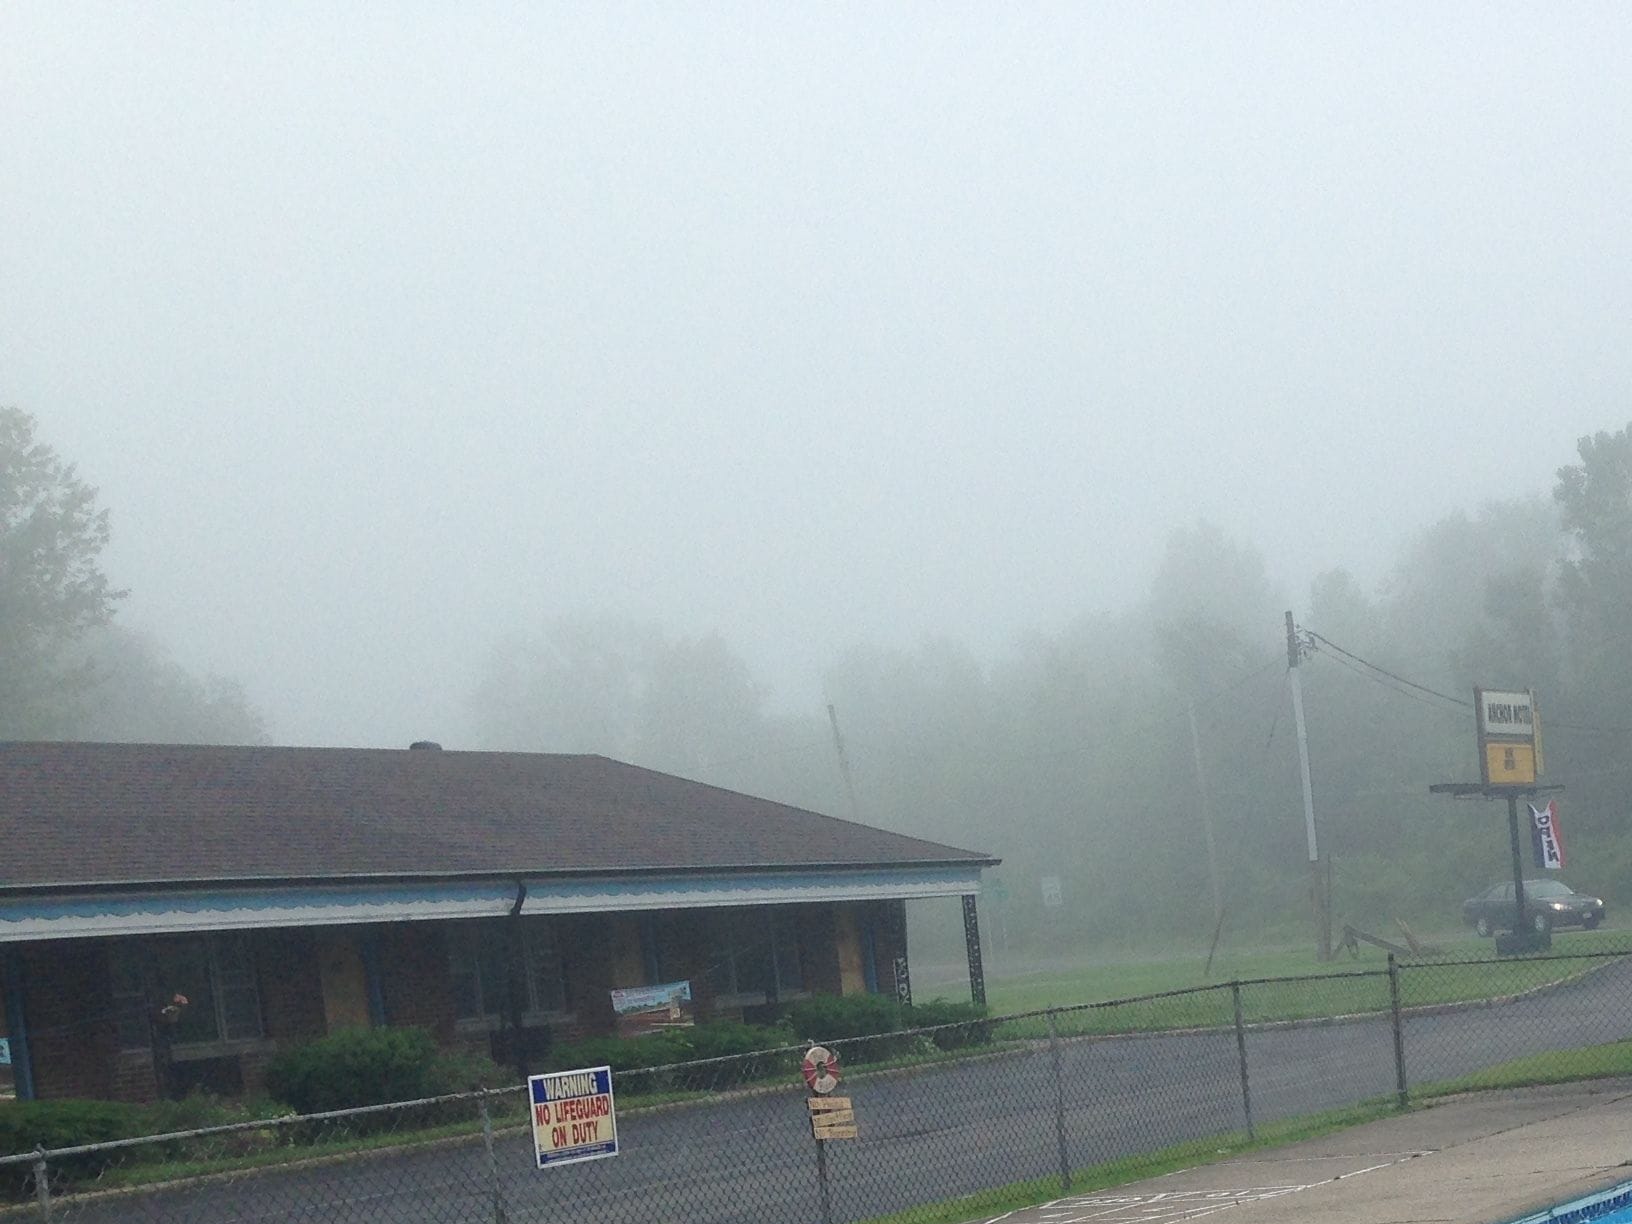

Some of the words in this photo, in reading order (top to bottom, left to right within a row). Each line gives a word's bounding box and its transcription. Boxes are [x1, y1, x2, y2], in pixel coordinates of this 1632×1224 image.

[542, 1072, 598, 1101] WARNING
[535, 1104, 551, 1127] NO
[555, 1095, 610, 1123] LIFEGUARD
[551, 1126, 568, 1148] ON
[572, 1120, 599, 1145] DUTY
